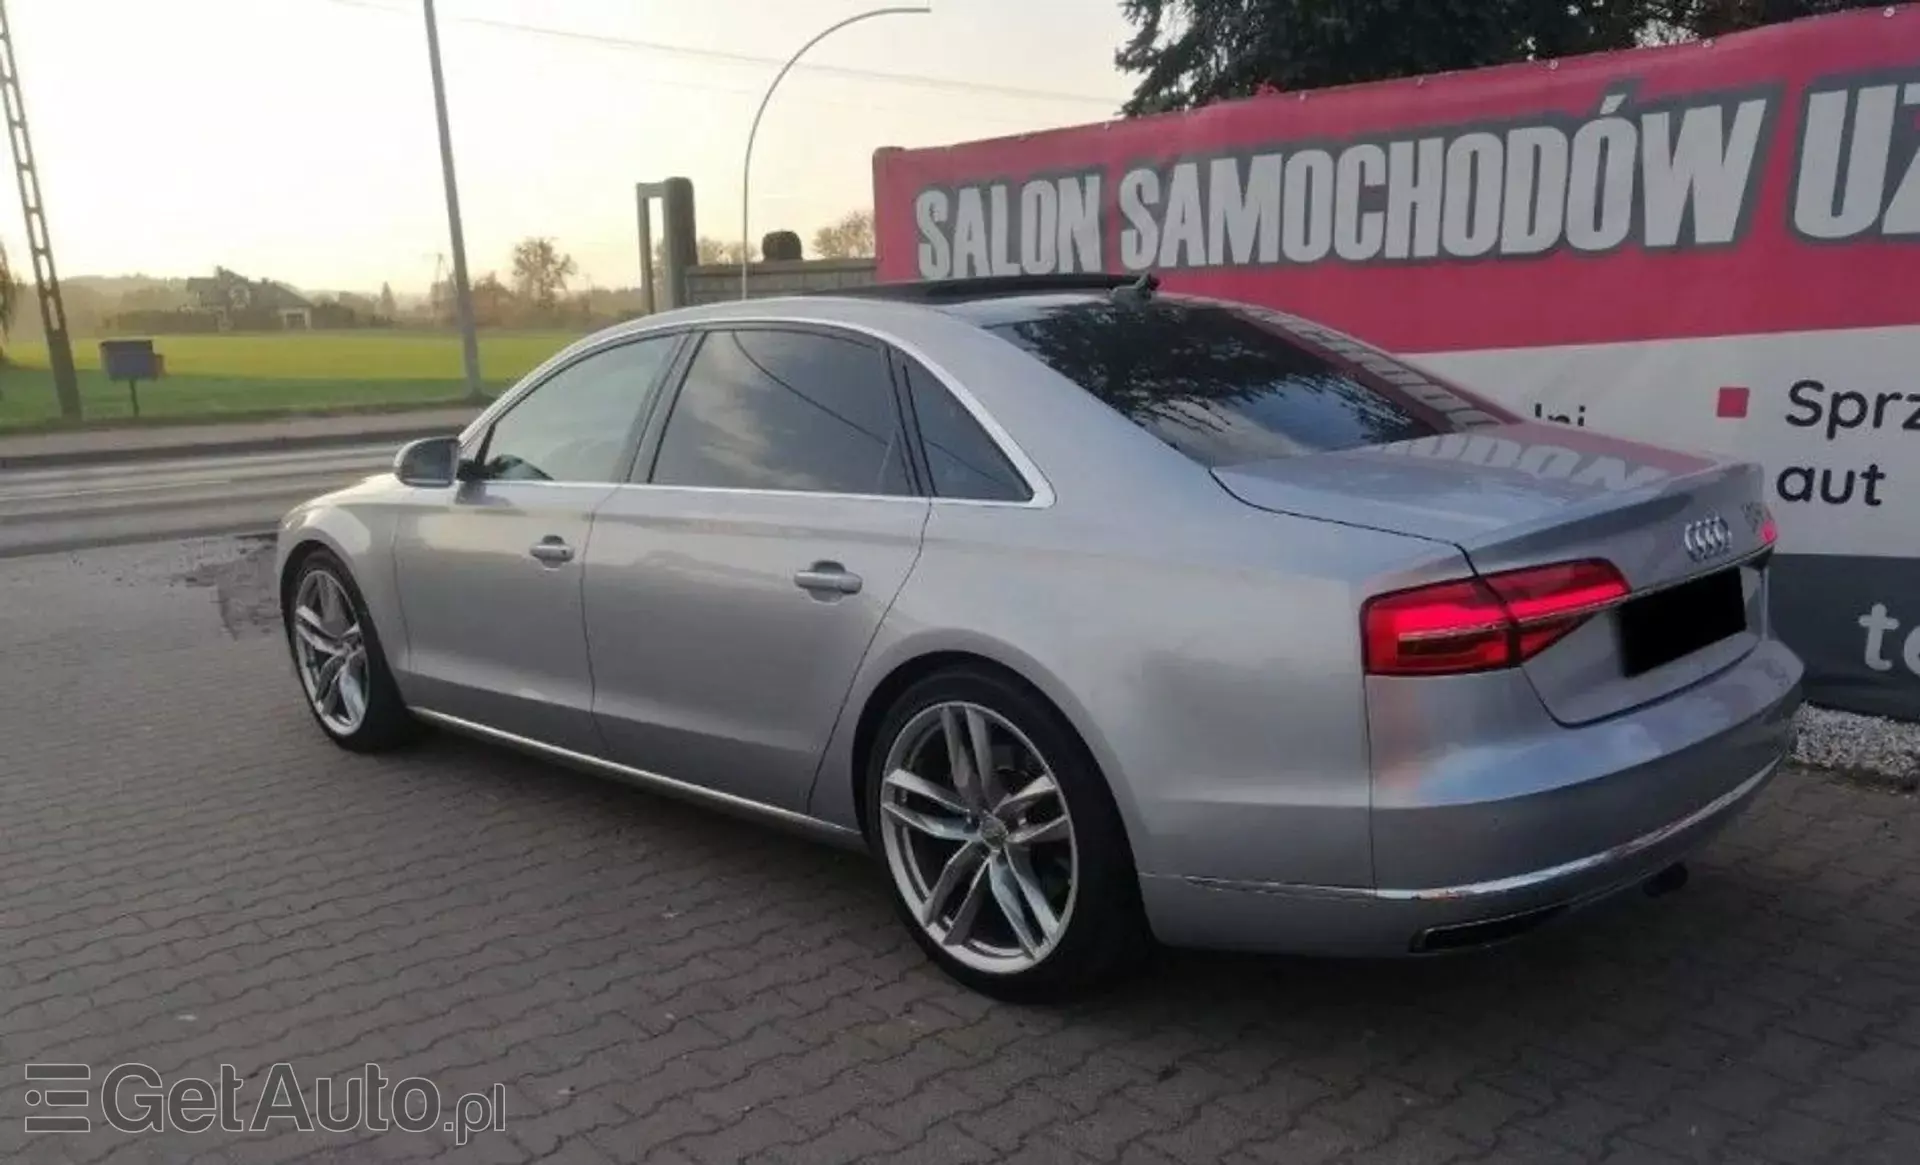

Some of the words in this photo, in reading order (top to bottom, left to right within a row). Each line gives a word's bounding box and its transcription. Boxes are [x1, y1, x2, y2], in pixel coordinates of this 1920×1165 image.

[916, 174, 1102, 280] SALON
[1119, 94, 1767, 271] SAMOCHODÓW
[1776, 463, 1886, 506] aut
